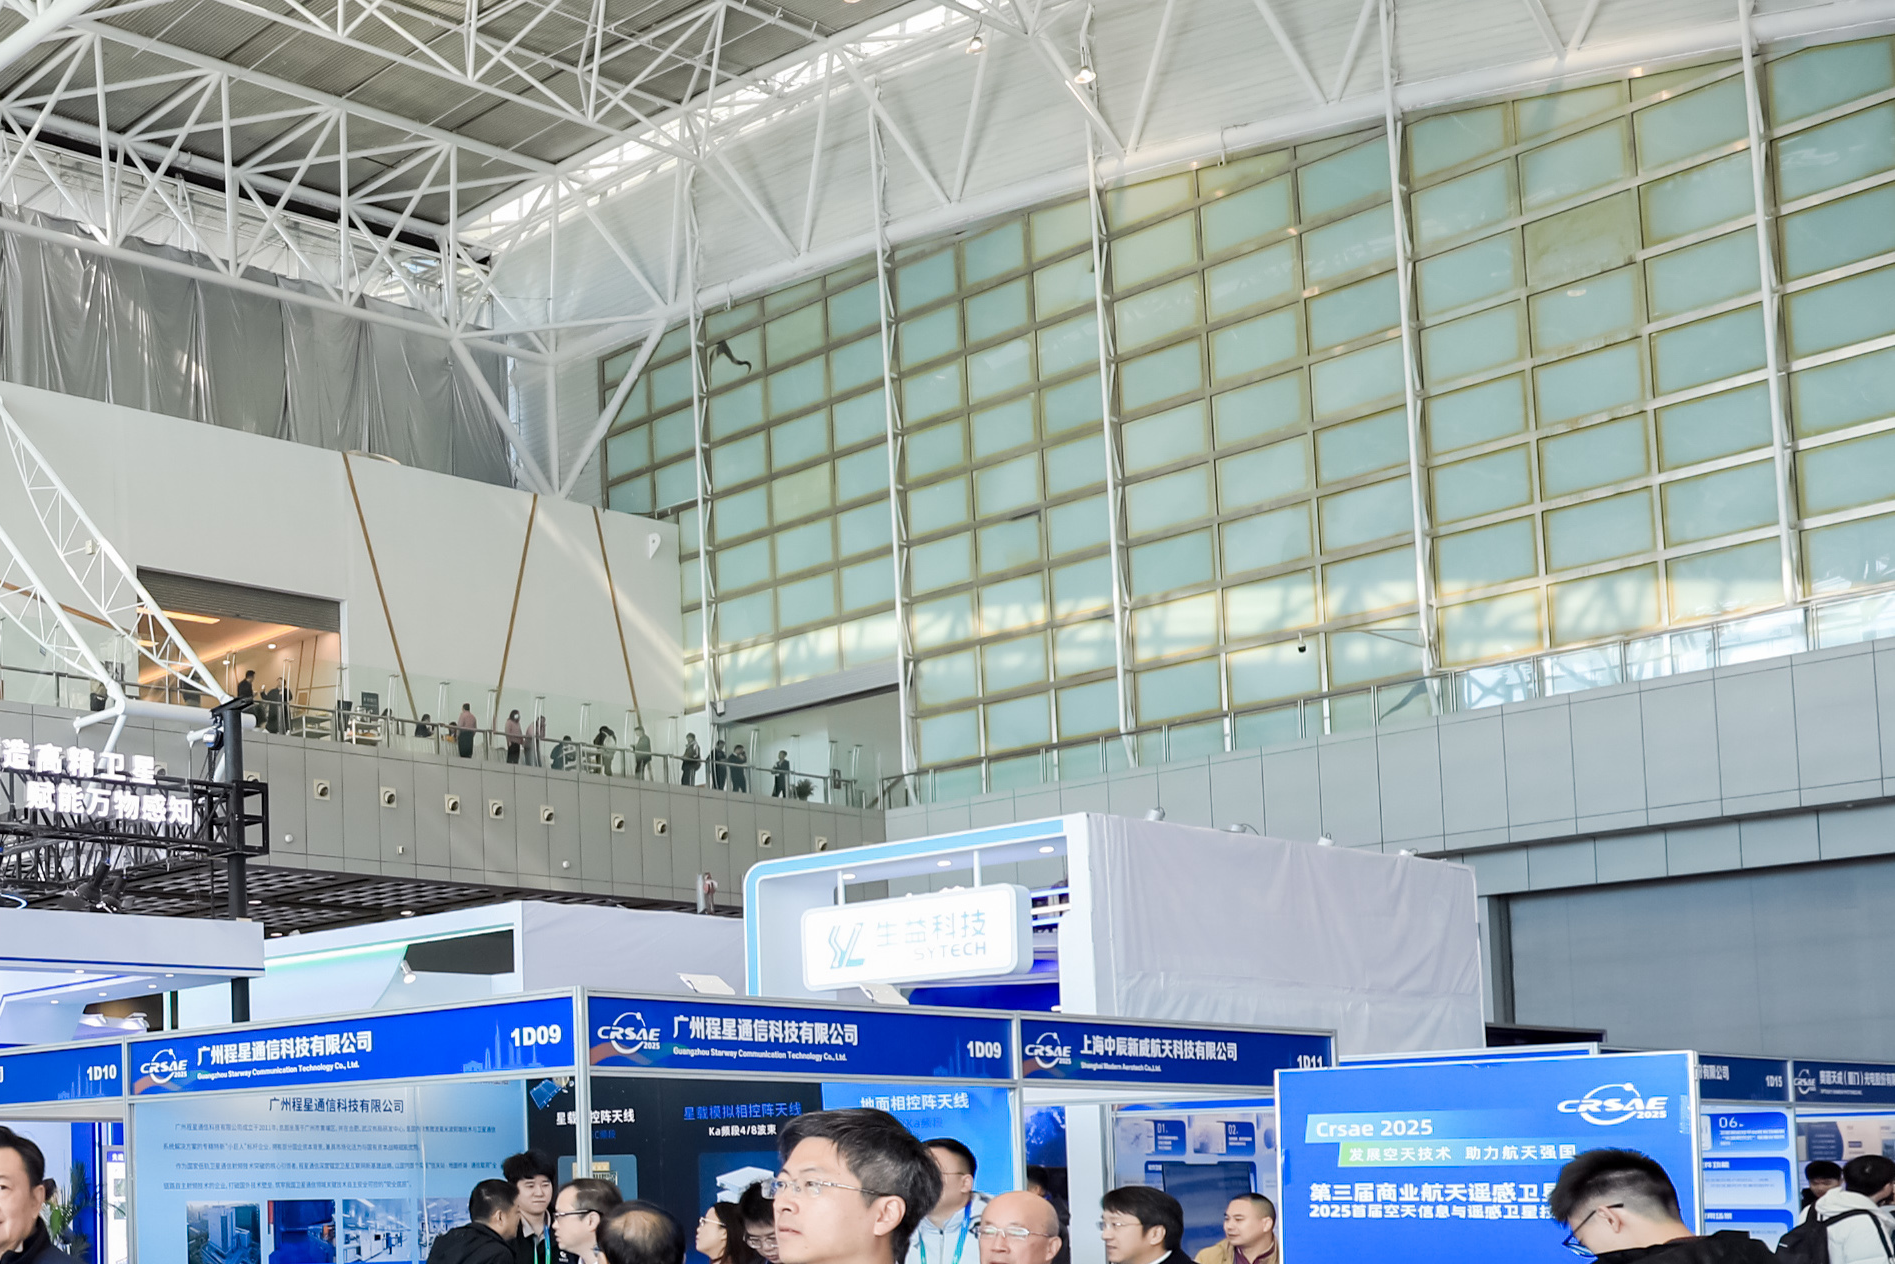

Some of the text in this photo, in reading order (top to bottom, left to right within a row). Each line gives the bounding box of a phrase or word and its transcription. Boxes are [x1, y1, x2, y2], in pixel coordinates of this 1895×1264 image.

[25, 779, 194, 826] 赋能万物感知
[876, 909, 986, 947] 生益科技
[913, 941, 987, 961] SYTECH
[510, 1023, 562, 1047] 1D09
[597, 1025, 661, 1042] CRSAE
[672, 1014, 859, 1046] 广州程星通信科技有限公司
[196, 1030, 373, 1067] 广州程星通信科技有限公司
[643, 1041, 661, 1050] 2025
[672, 1046, 710, 1057] Guangzhou
[710, 1048, 737, 1059] Starway
[737, 1049, 787, 1060] Communication
[787, 1050, 823, 1062] Technology
[967, 1040, 1002, 1060] 1D09
[1024, 1044, 1072, 1058] CRSAE
[1080, 1033, 1238, 1062] 上海中辰新威航天科技有限公司
[139, 1058, 188, 1075] CRSAE
[1080, 1061, 1103, 1071] Shanghai
[1296, 1055, 1323, 1069] 1D11
[86, 1064, 117, 1082] 1D10
[173, 1070, 188, 1079] 2025
[196, 1070, 228, 1082] Guangzhou
[227, 1068, 252, 1079] Starway
[252, 1066, 298, 1077] Communication
[298, 1062, 334, 1074] Technology
[1765, 1075, 1783, 1088] 1D15
[268, 1096, 404, 1114] 广州程星通信科技有限公司
[683, 1101, 802, 1121] 星载模拟相控阵天线
[860, 1092, 970, 1112] 地面相控阵天线
[1557, 1096, 1669, 1113] CRSAE
[555, 1107, 636, 1126] 星载控阵天线
[1636, 1110, 1668, 1120] 2025
[1316, 1119, 1434, 1138] Crsae 2025
[1348, 1143, 1577, 1163] 发展空天技术 助力航天强国
